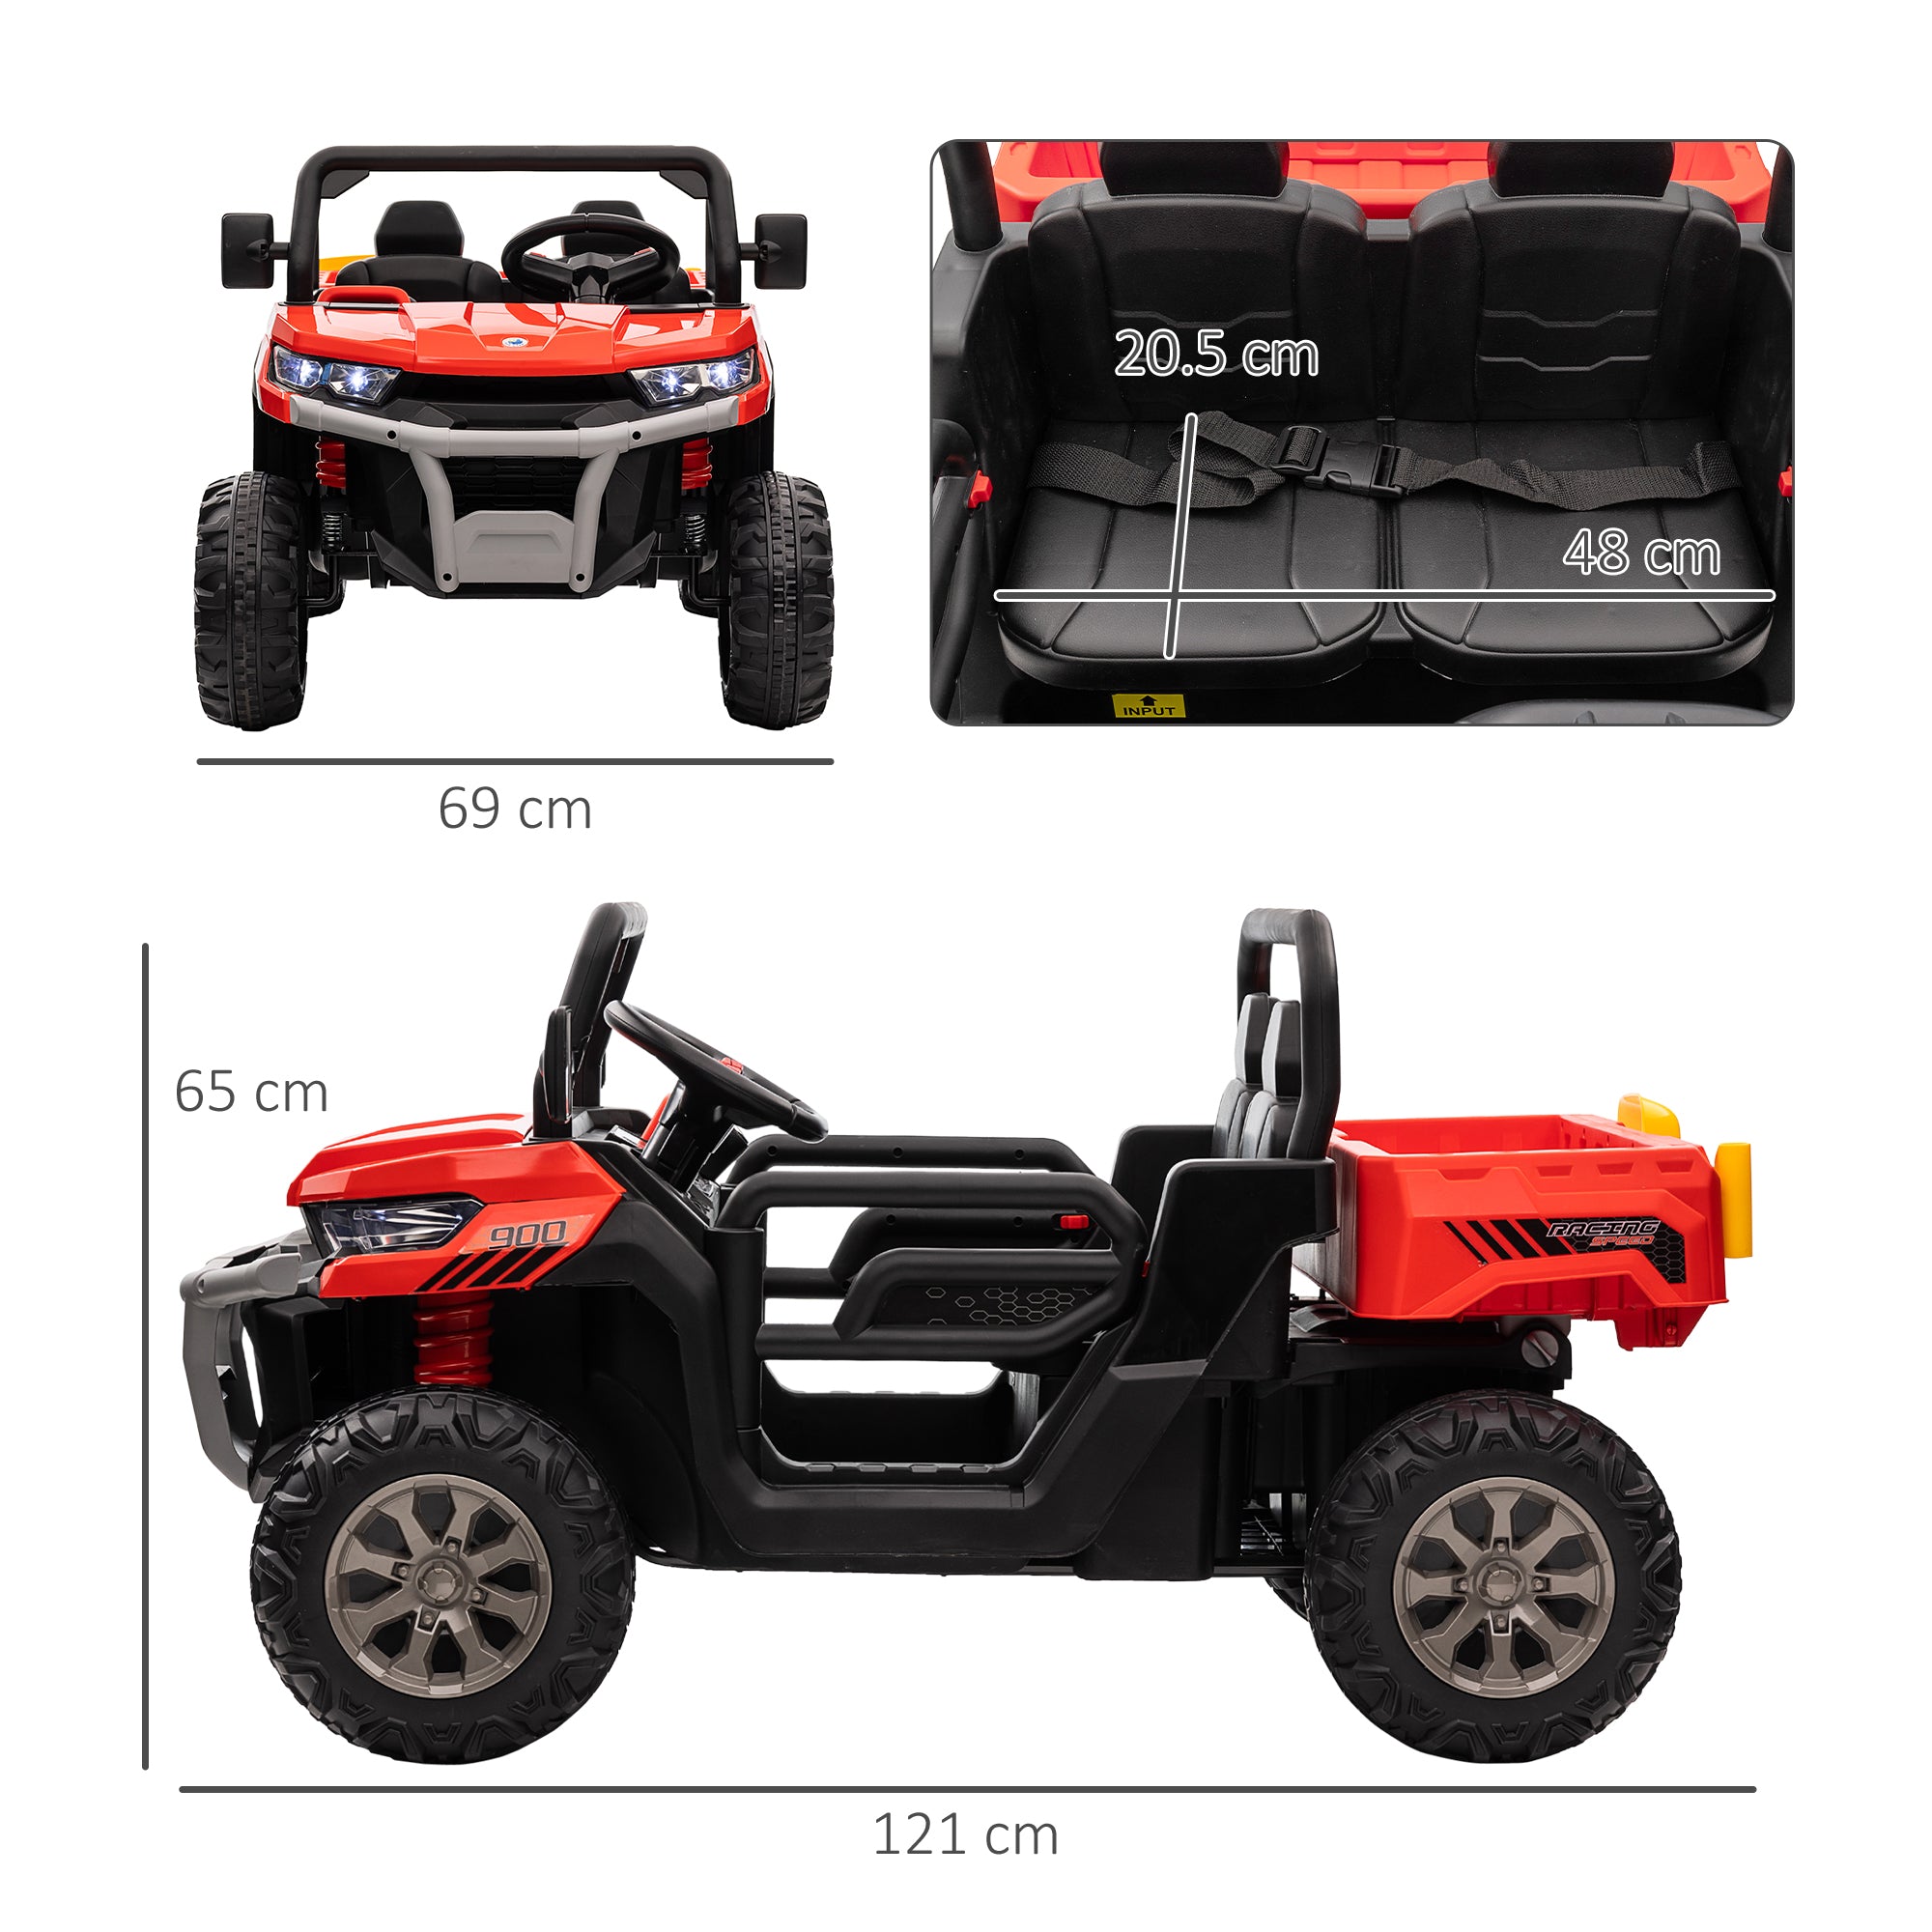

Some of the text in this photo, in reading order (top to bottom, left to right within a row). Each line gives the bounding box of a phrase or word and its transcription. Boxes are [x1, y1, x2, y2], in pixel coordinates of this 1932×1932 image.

[1122, 706, 1176, 716] INPUT
[1546, 1220, 1662, 1236] RACING
[489, 1220, 567, 1250] 900
[1589, 1236, 1655, 1247] SPEED
